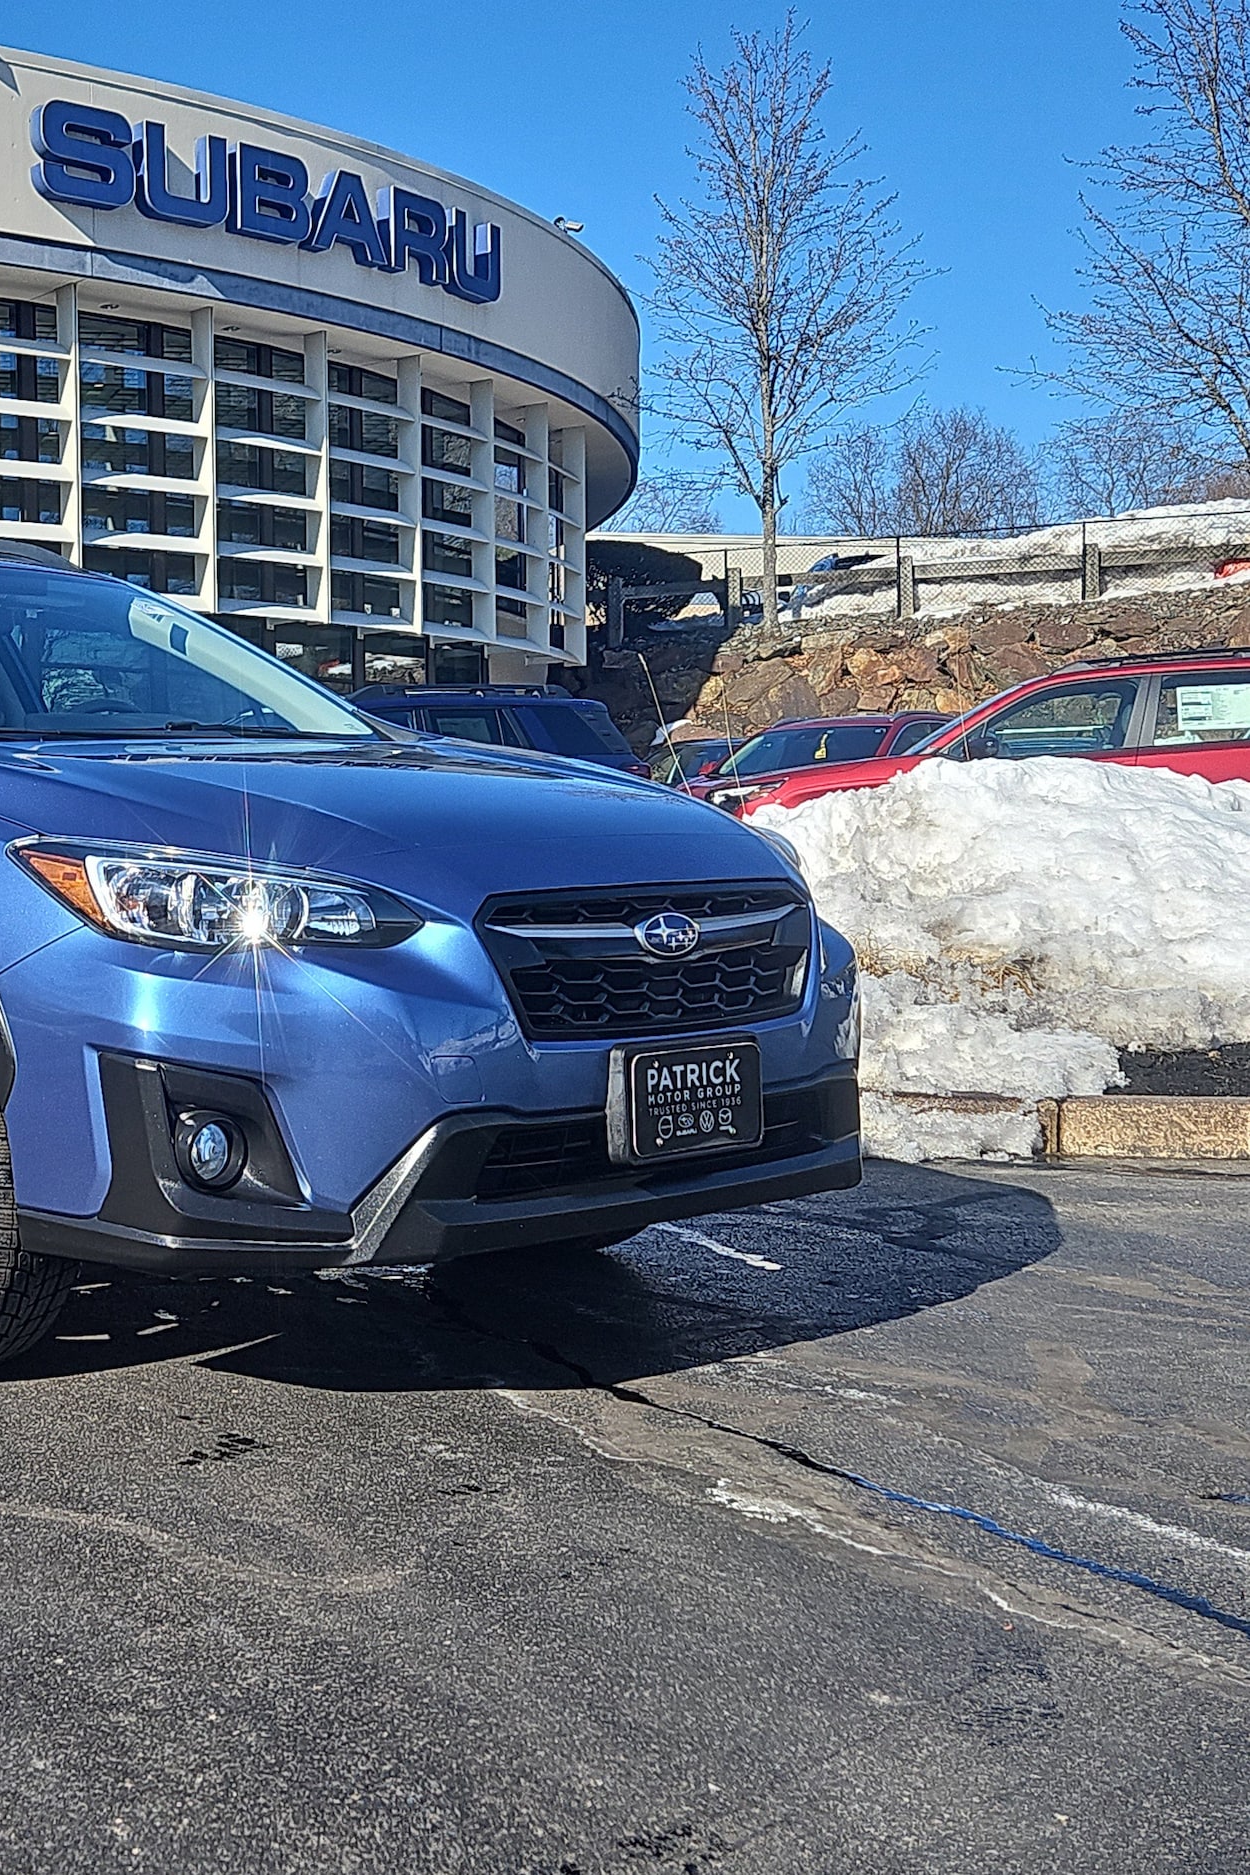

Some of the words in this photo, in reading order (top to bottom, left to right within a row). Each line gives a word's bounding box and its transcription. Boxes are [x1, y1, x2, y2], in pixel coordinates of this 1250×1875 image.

[30, 99, 501, 303] SUBARU
[647, 1058, 740, 1093] PATRICK
[648, 1090, 690, 1105] MOTOR
[697, 1084, 741, 1099] GROUP
[648, 1103, 688, 1116] TRUSTED
[691, 1099, 717, 1110] SINCE
[721, 1096, 741, 1107] 1936
